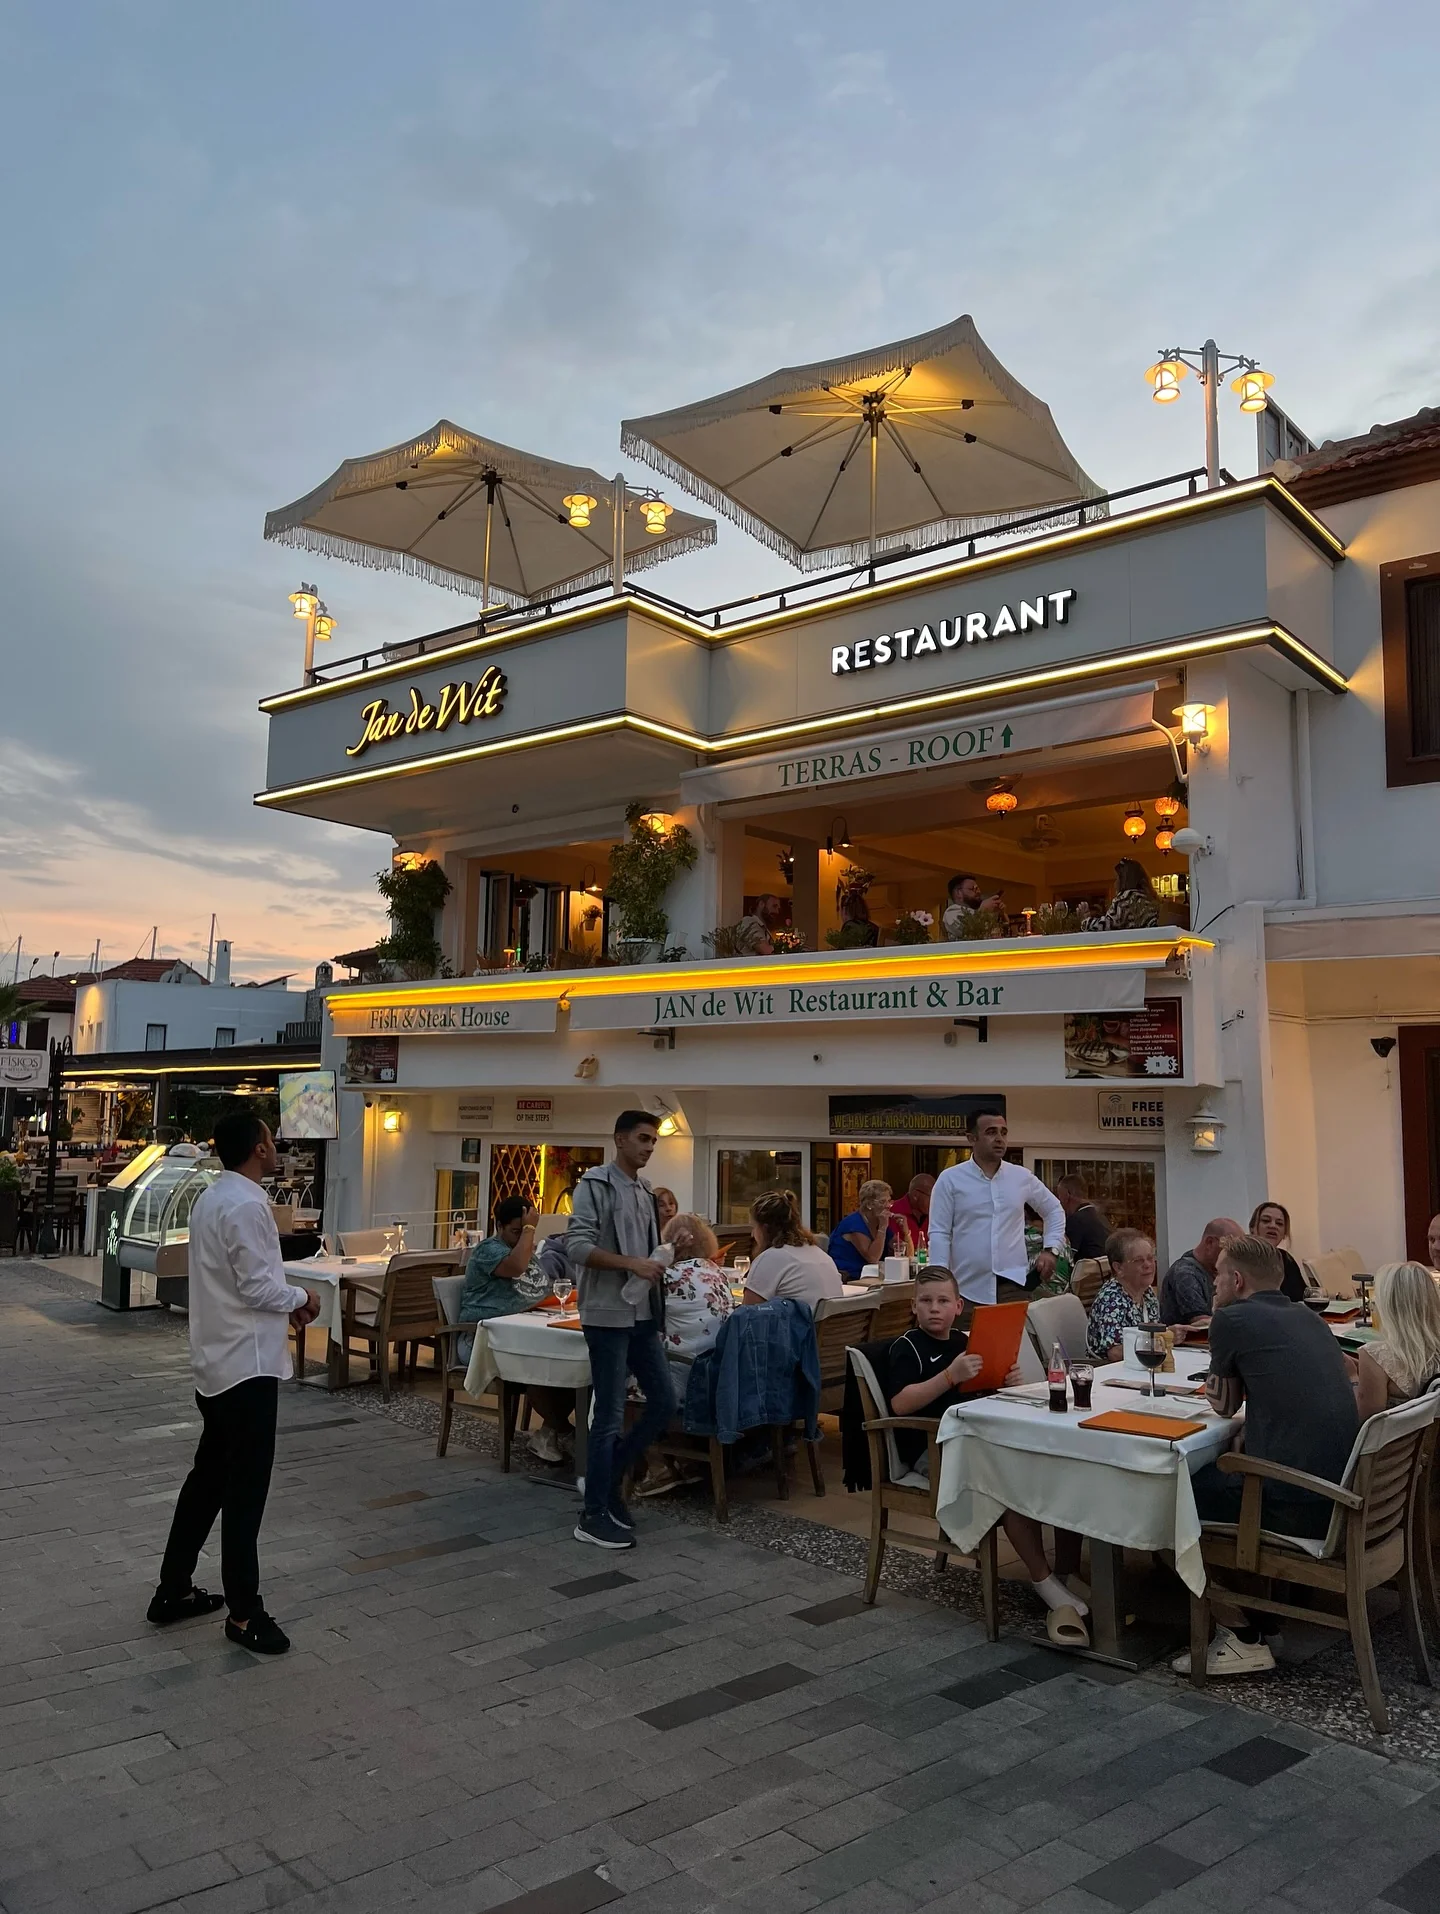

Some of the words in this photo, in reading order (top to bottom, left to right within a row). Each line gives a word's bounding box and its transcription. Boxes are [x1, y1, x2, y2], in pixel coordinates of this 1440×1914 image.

[832, 589, 1075, 674] RESTAURANT
[345, 699, 404, 756] Jan
[405, 687, 434, 734] de
[436, 665, 506, 730] Wit
[778, 747, 881, 787] TERRAS
[907, 727, 995, 766] ROOF
[654, 994, 697, 1025] JAN
[702, 991, 726, 1017] de
[733, 991, 774, 1015] Wit
[788, 984, 919, 1013] Restaurant
[926, 981, 949, 1008] &
[956, 980, 1004, 1007] Bar
[370, 1008, 398, 1029] Fish
[402, 1008, 414, 1029] &
[418, 1006, 457, 1029] Steak
[460, 1006, 510, 1027] House
[519, 1101, 525, 1109] BE
[1132, 1101, 1164, 1112] FREE
[516, 1113, 524, 1122] OF
[525, 1113, 534, 1122] THE
[535, 1113, 550, 1122] STEPS
[835, 1115, 846, 1129] WE
[850, 1115, 869, 1129] HAVE
[871, 1115, 883, 1128] AN
[1101, 1116, 1164, 1127] WIRELESS
